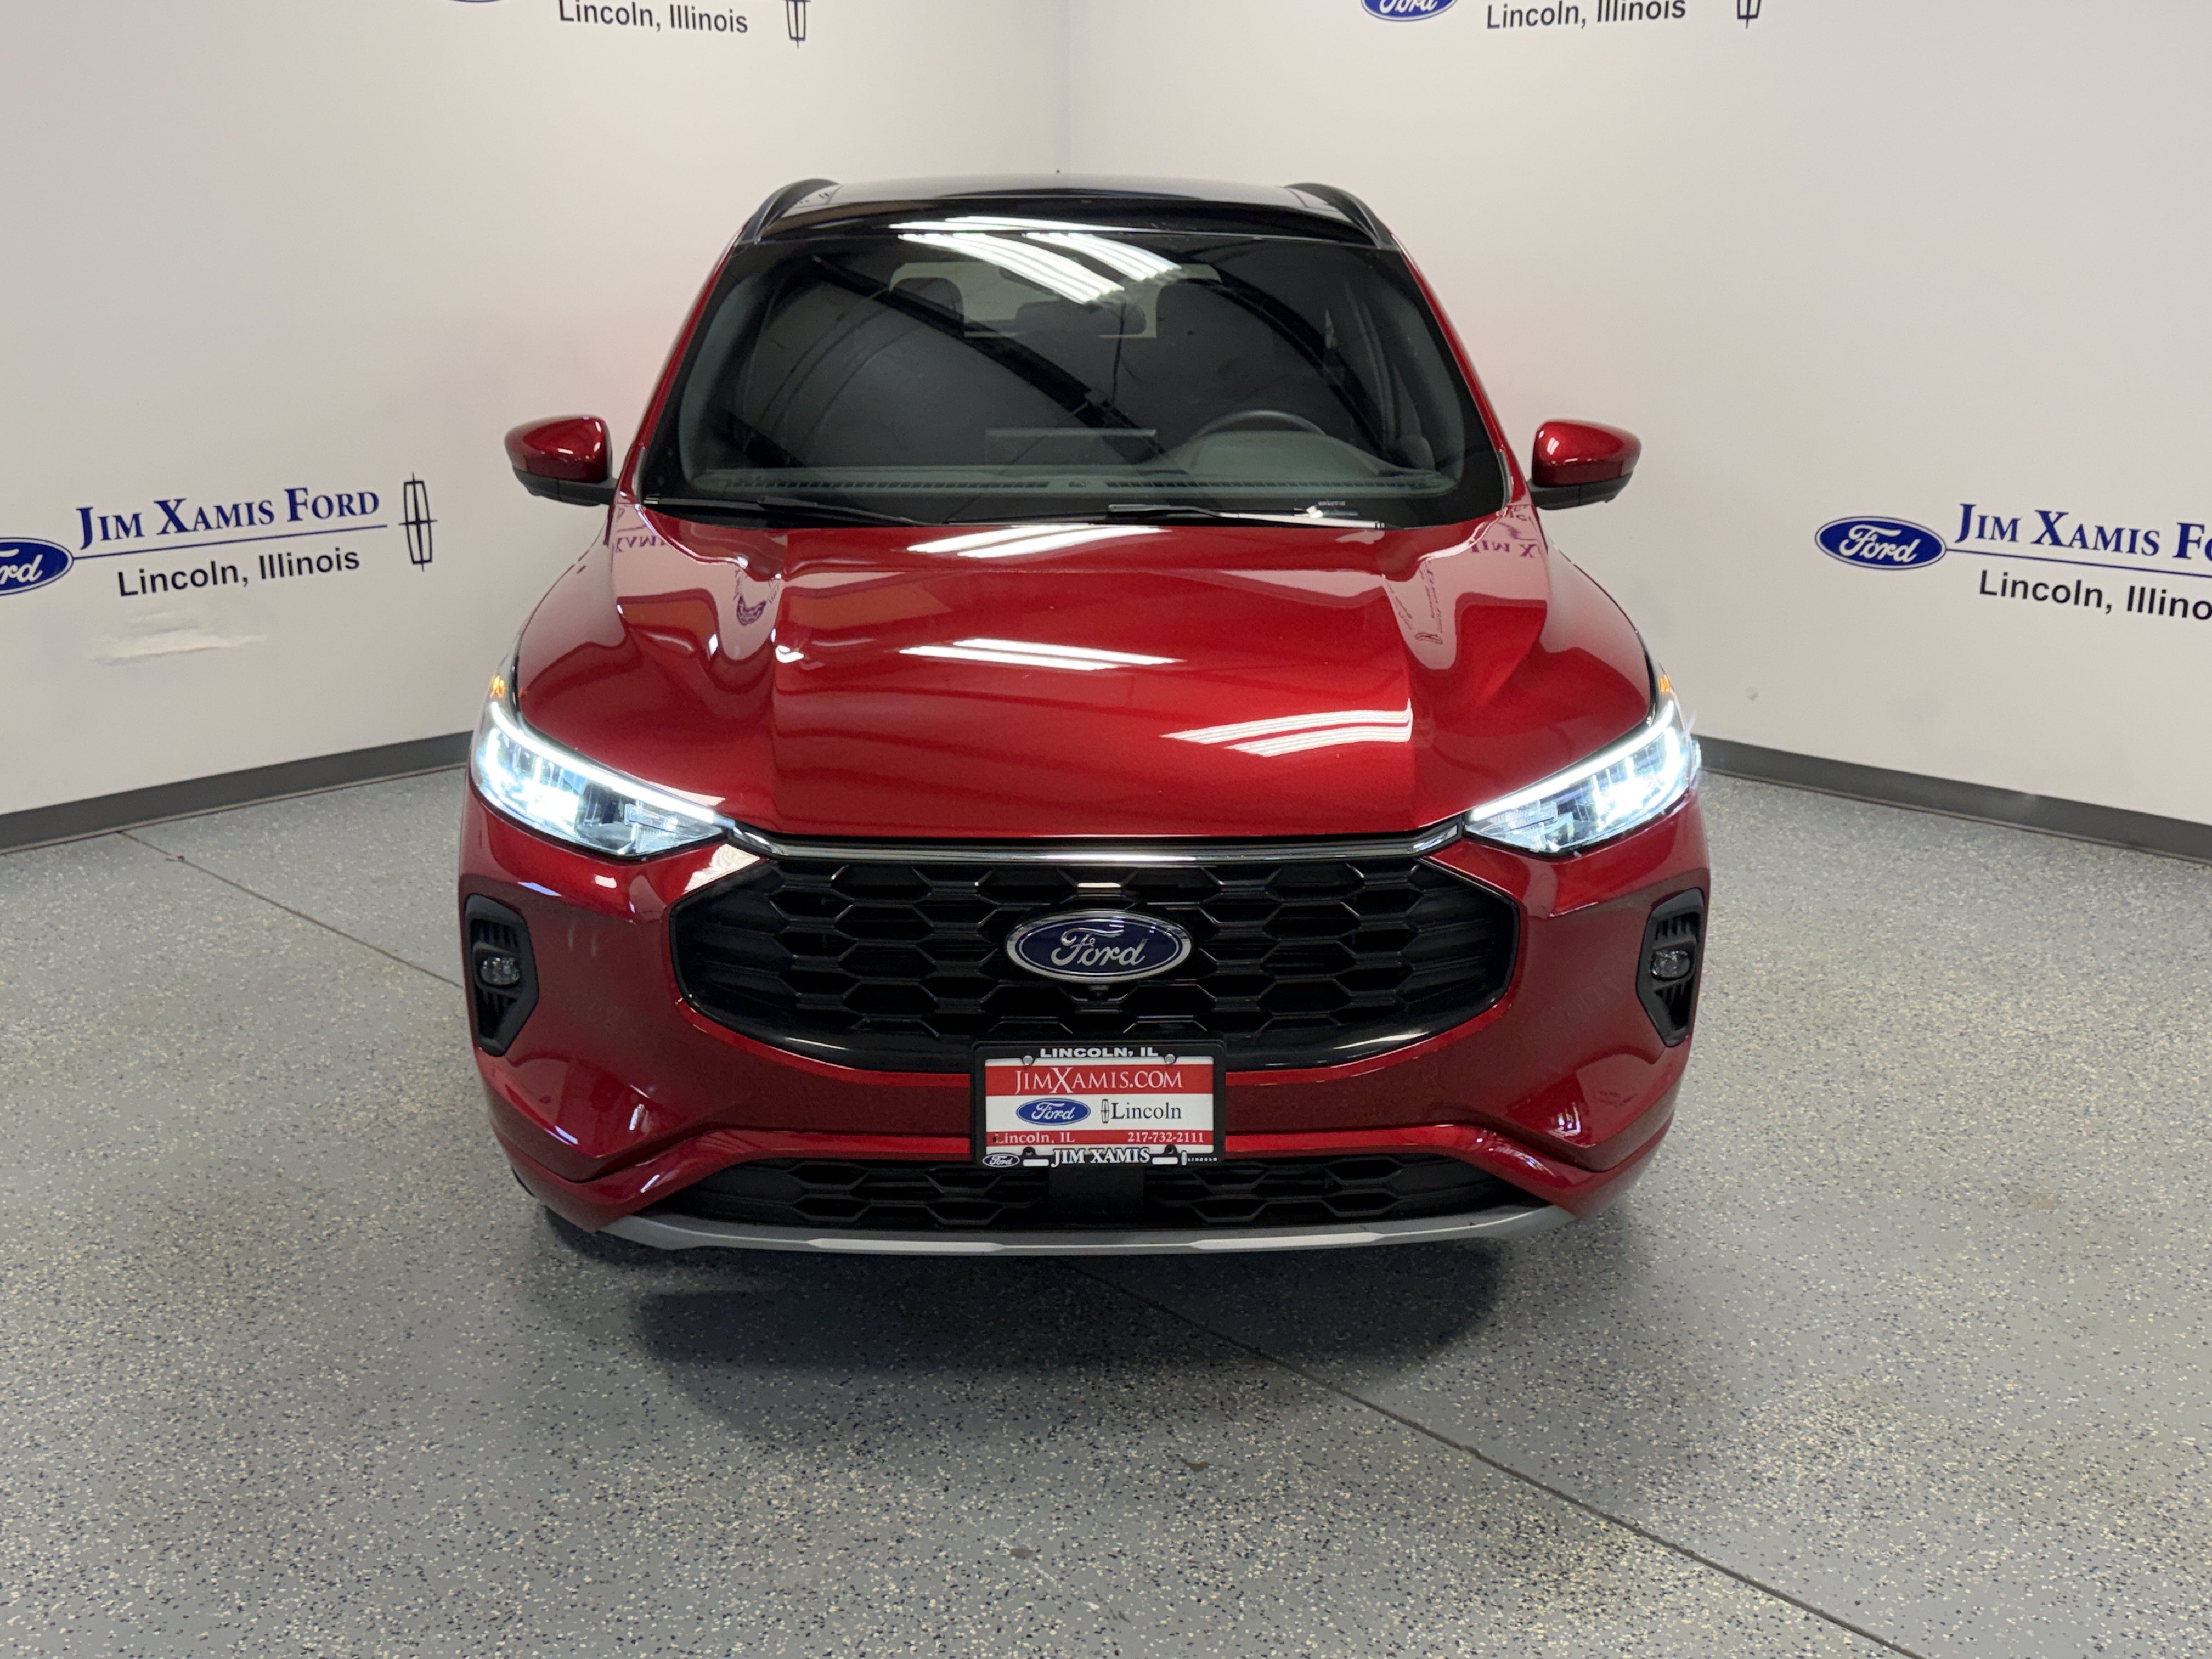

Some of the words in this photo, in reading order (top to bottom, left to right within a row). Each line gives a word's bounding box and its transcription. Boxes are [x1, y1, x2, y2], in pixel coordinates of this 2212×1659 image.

[558, 0, 661, 32] Lincoln,
[669, 4, 748, 33] Illinois
[1486, 3, 1587, 29] Lincoln,
[1596, 0, 1686, 23] Illinois
[76, 506, 145, 550] JIM
[154, 498, 275, 535] XAMIS
[284, 487, 380, 523] FORD
[1955, 503, 2021, 544] JIM
[2030, 510, 2160, 556] XAMIS
[1839, 524, 1921, 563] Ford
[117, 561, 250, 597] Lincoln,
[259, 546, 360, 580] Illinois
[1979, 569, 2113, 614] Lincoln,
[1051, 927, 1148, 966] Ford
[1040, 1047, 1133, 1058] LINCOLN,
[1140, 1047, 1158, 1057] IL
[1015, 1067, 1183, 1094] JIMXAMIS.COM
[1031, 1102, 1075, 1120] Ford
[1111, 1102, 1182, 1119] Lincoln
[996, 1132, 1055, 1144] Lincoln,
[1060, 1132, 1075, 1143] IL
[1127, 1132, 1204, 1143] 217-732-2111
[989, 1155, 1013, 1165] Ford
[1051, 1148, 1085, 1168] JIM
[1089, 1147, 1150, 1164] XAMIS
